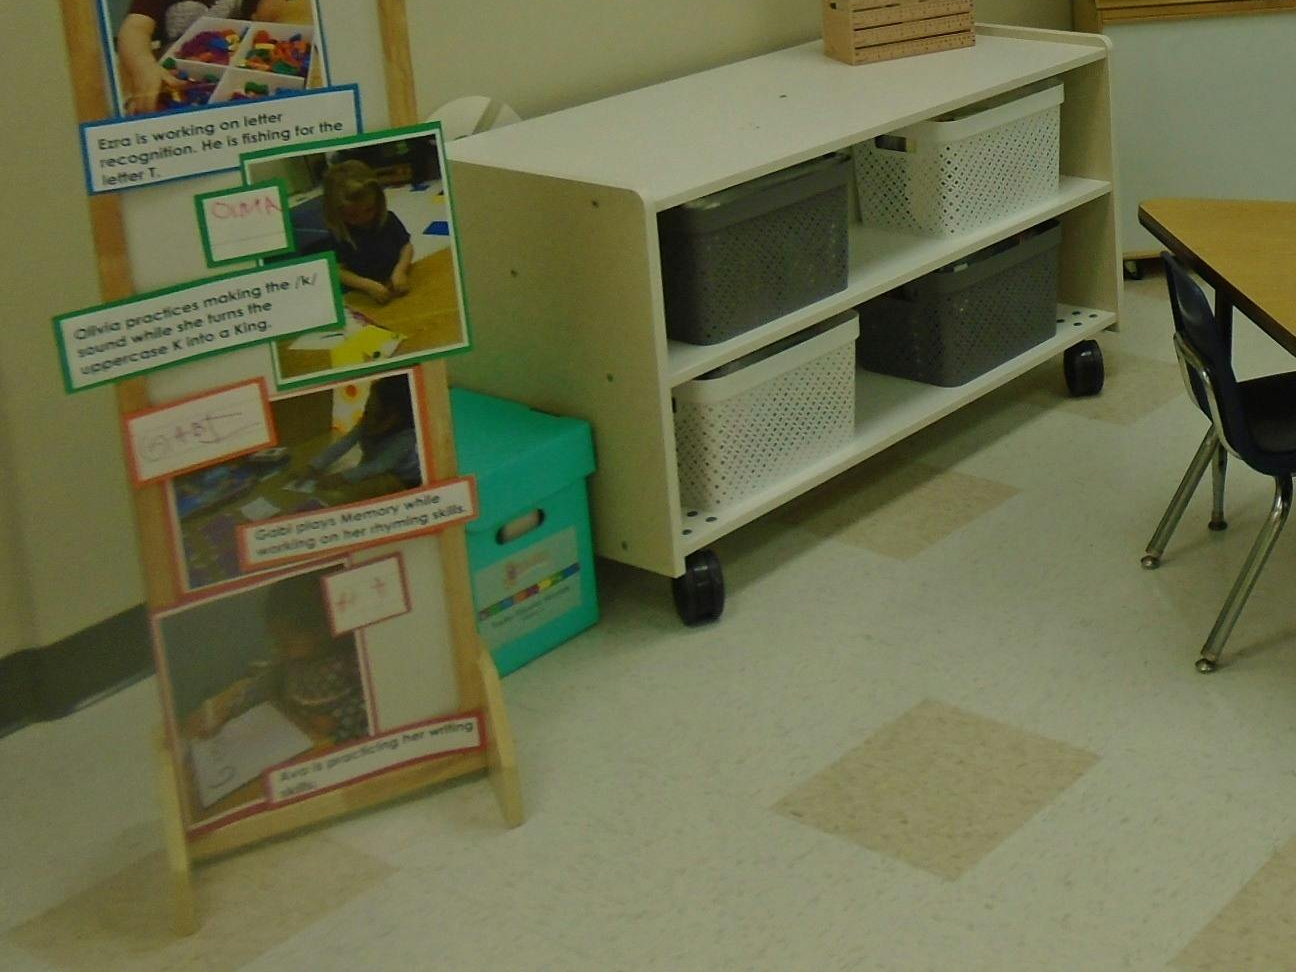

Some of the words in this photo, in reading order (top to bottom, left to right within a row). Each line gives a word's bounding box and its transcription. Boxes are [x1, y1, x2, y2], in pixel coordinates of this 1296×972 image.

[98, 136, 131, 150] Ezra
[135, 133, 147, 145] is
[152, 120, 215, 142] working
[219, 118, 240, 131] on
[243, 112, 283, 128] letter
[100, 144, 198, 168] recognition.
[202, 138, 223, 153] He
[227, 135, 238, 147] is
[242, 126, 291, 146] fishing
[295, 123, 315, 136] for
[319, 120, 343, 134] the
[102, 170, 145, 186] letter
[74, 320, 121, 341] Olivia
[125, 302, 199, 330] practices
[203, 288, 262, 310] making
[265, 280, 290, 295] the
[77, 338, 127, 358] sound
[132, 327, 173, 346] while
[177, 317, 204, 332] she
[207, 309, 244, 325] turns
[247, 301, 273, 316] the
[80, 345, 168, 375] uppercase
[173, 339, 183, 352] K
[187, 329, 215, 346] into
[219, 330, 230, 340] a
[234, 318, 272, 337] King.
[257, 536, 317, 556] working
[320, 531, 339, 545] on
[343, 526, 367, 540] her
[370, 512, 429, 534] rhyming
[296, 518, 338, 534] plays
[341, 504, 400, 524] Memory
[405, 494, 441, 510] while
